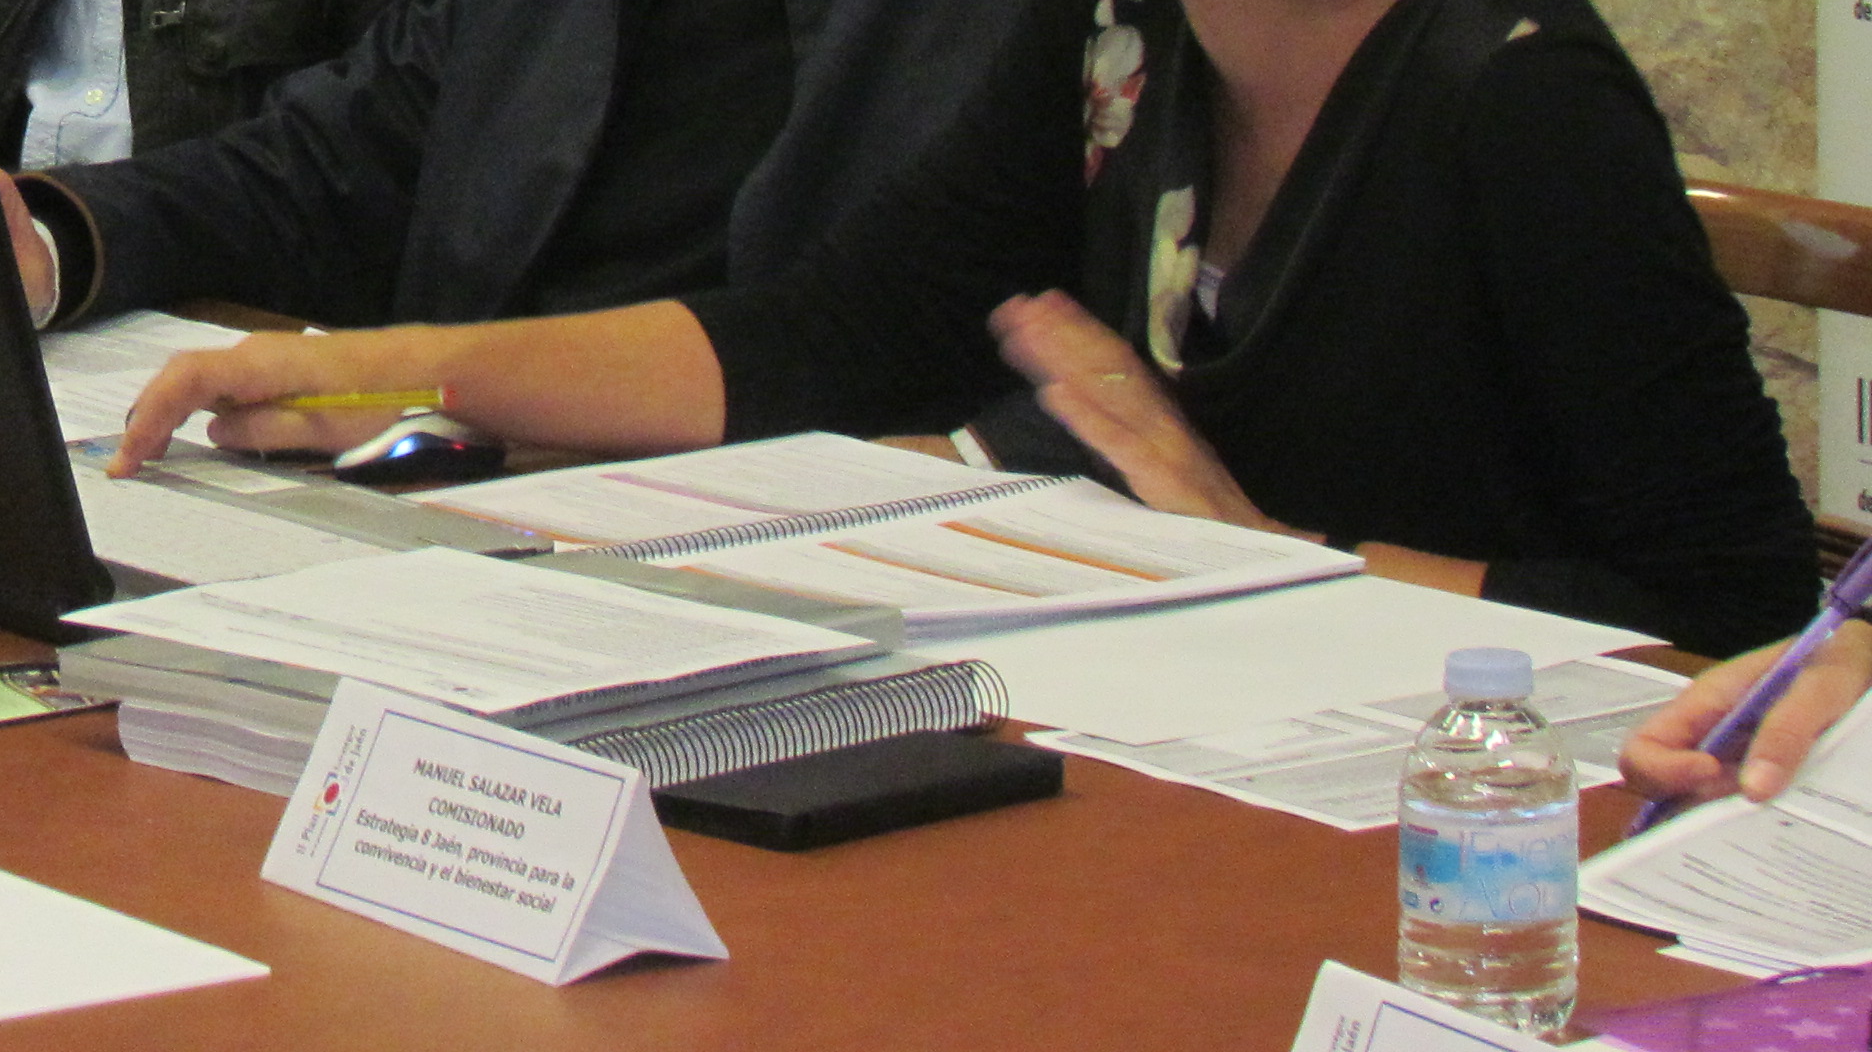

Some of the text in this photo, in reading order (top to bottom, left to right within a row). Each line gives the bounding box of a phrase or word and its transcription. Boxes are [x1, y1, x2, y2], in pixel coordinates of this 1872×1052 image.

[414, 757, 563, 816] MANUEL SALAZAR VELA
[428, 796, 525, 839] COMISIONADO
[354, 839, 557, 913] convivencia y el bienestar social
[356, 808, 419, 842] Estrategia
[466, 847, 528, 877] provincia
[528, 866, 561, 887] para
[562, 872, 575, 891] la
